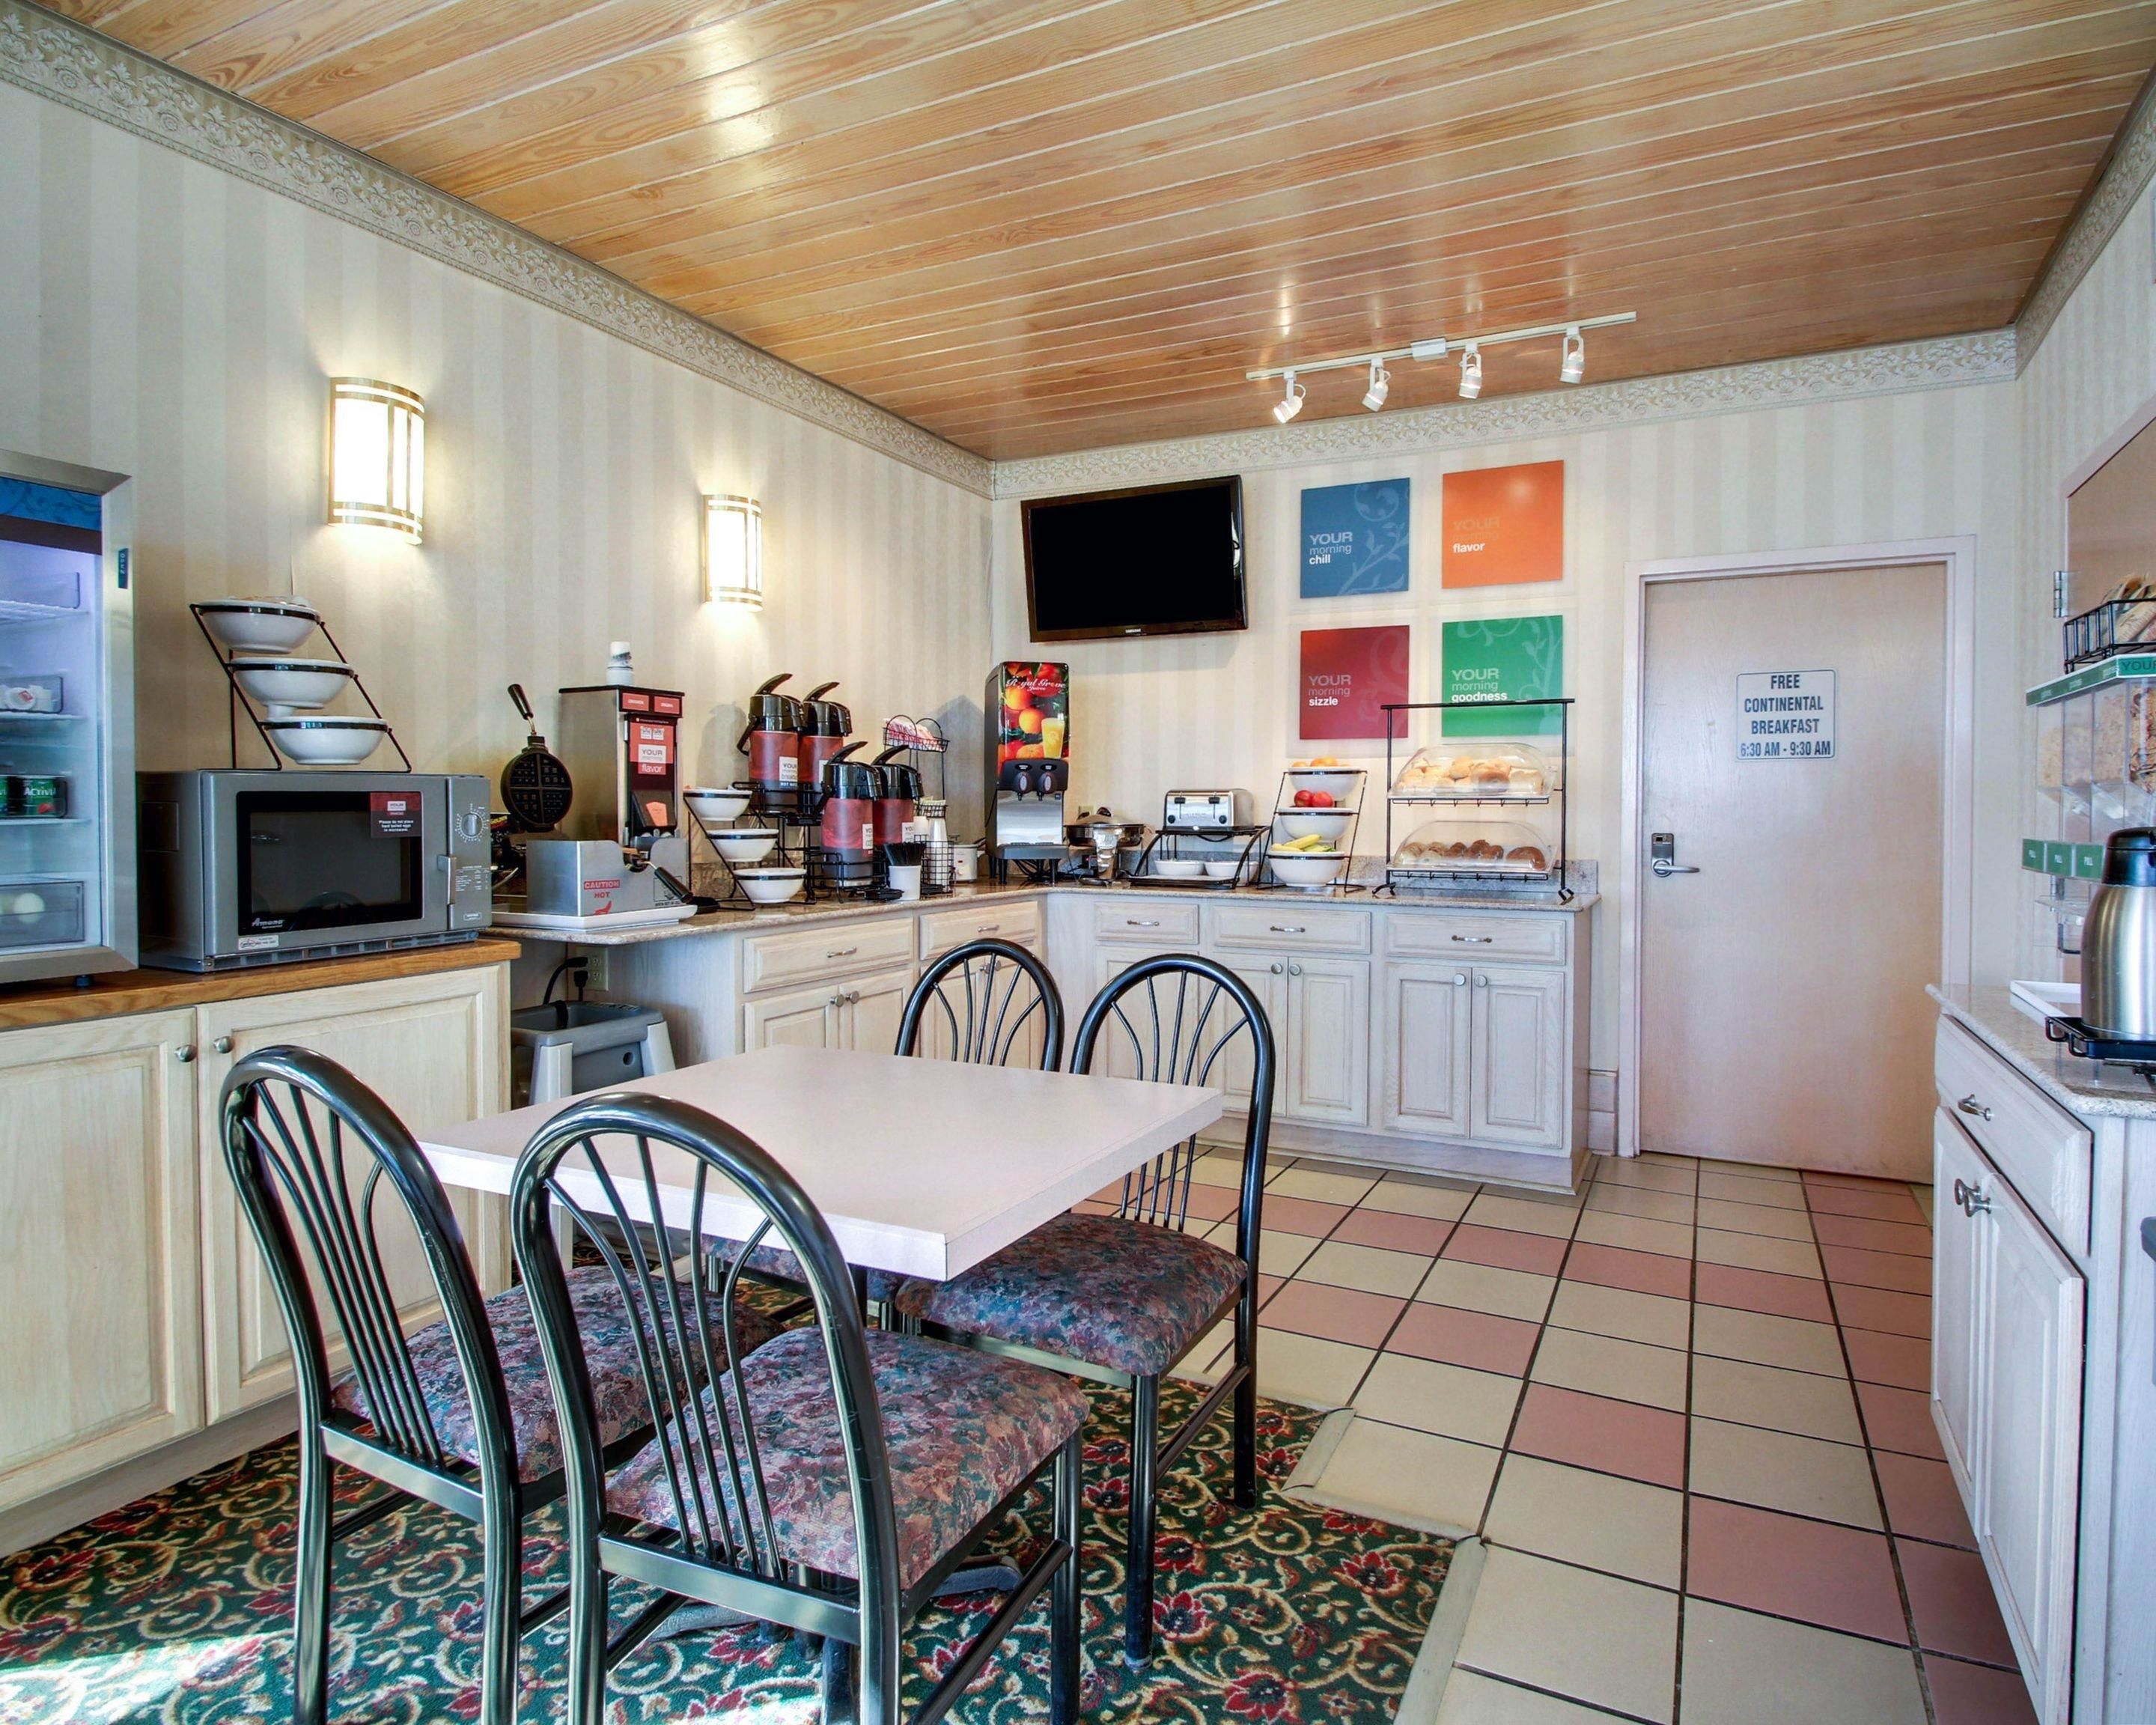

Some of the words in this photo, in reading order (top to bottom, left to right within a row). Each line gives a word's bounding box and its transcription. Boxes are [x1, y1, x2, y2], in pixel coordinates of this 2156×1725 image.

[1309, 532, 1353, 545] YOUR
[1310, 544, 1352, 555] morning
[1453, 543, 1486, 553] flavor
[1309, 554, 1331, 565] chill
[1452, 668, 1499, 681] YOUR
[1309, 675, 1351, 686] YOUR
[1770, 675, 1800, 689] FREE
[1309, 687, 1350, 697] morning
[1452, 681, 1498, 692] morning
[1309, 696, 1339, 706] sizzle
[1452, 691, 1508, 703] goodness
[1744, 696, 1824, 713] CONTINENTAL
[1751, 719, 1820, 734] BREAKFAST
[1740, 743, 1761, 757] 6:30
[1764, 742, 1780, 756] AM
[1790, 741, 1812, 755] 9:30
[1814, 740, 1830, 755] AM
[642, 764, 663, 773] flavor
[585, 880, 620, 889] CAUTION
